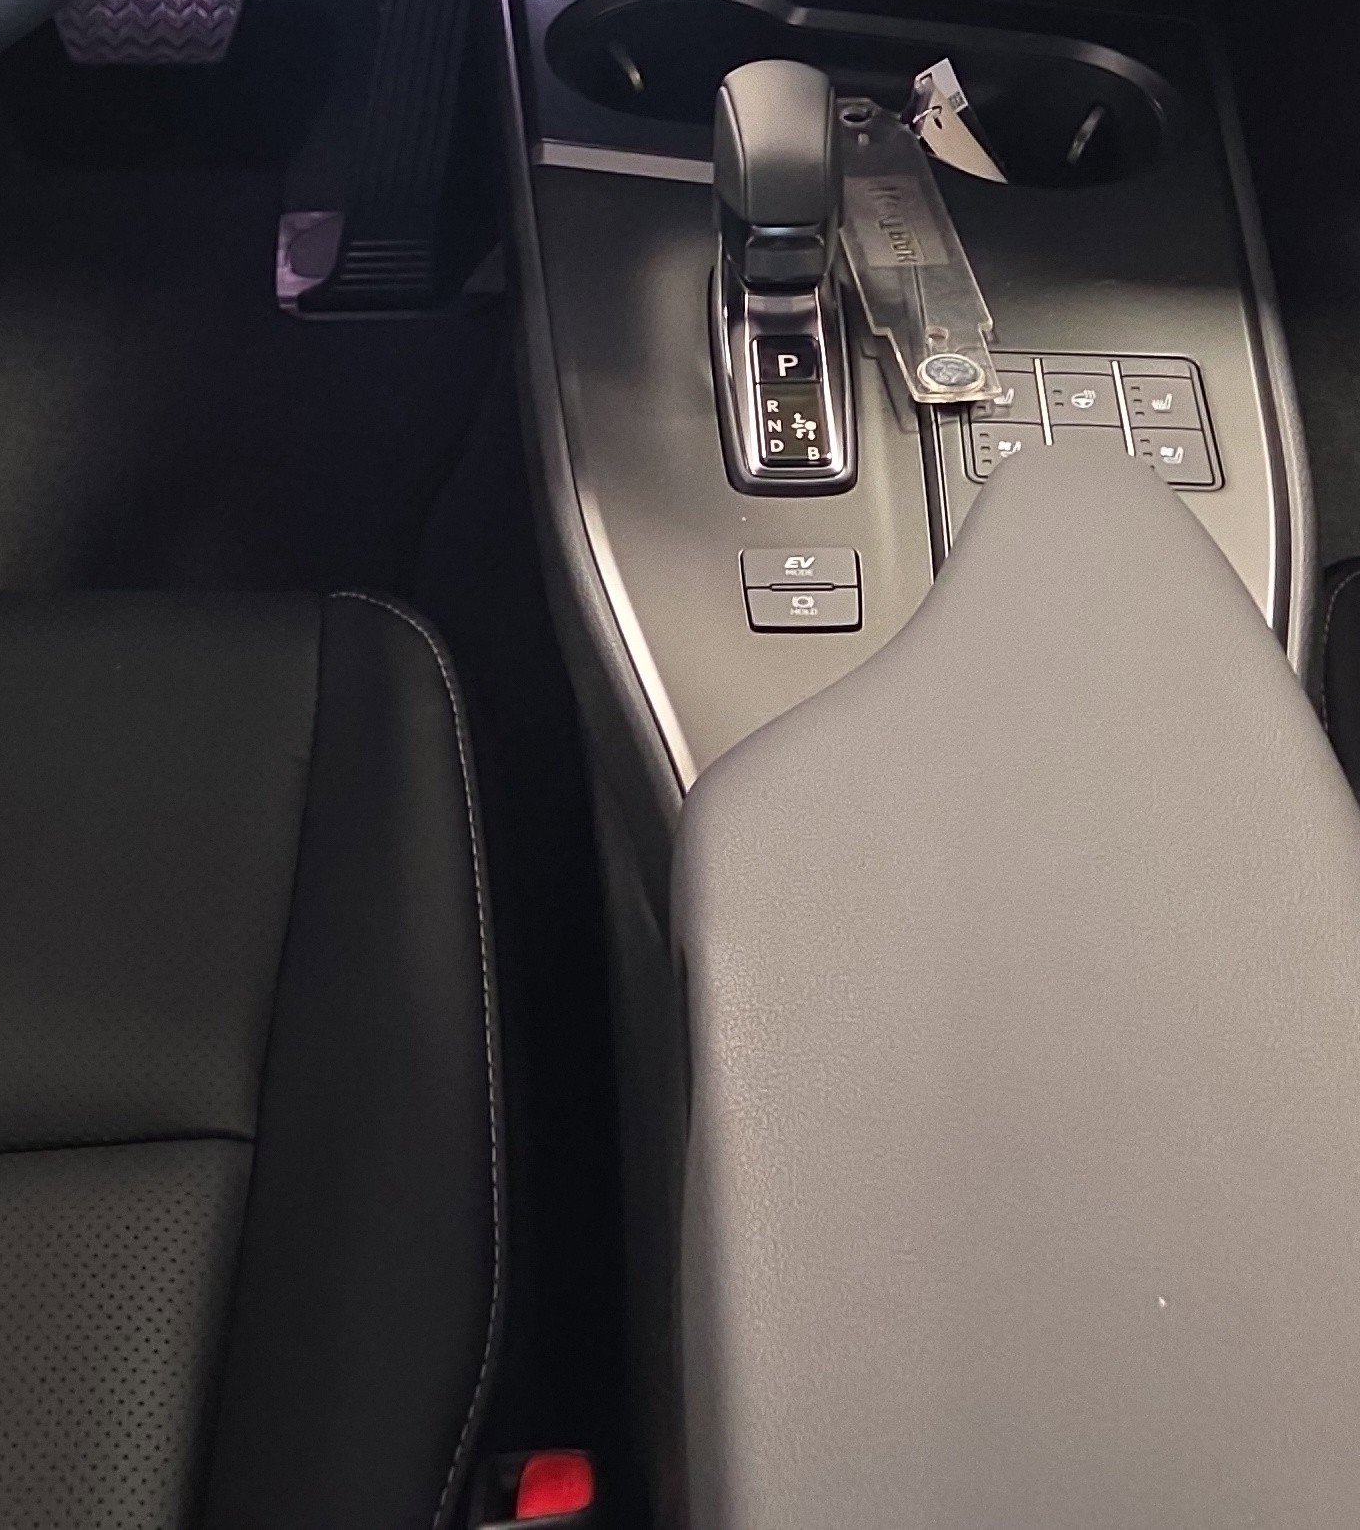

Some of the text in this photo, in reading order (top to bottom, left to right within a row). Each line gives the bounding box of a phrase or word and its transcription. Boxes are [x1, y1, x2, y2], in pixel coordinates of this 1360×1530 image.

[777, 354, 799, 377] P
[766, 399, 780, 413] R
[767, 419, 783, 433] N
[770, 439, 785, 453] D
[807, 446, 821, 461] B
[784, 555, 816, 569] EV
